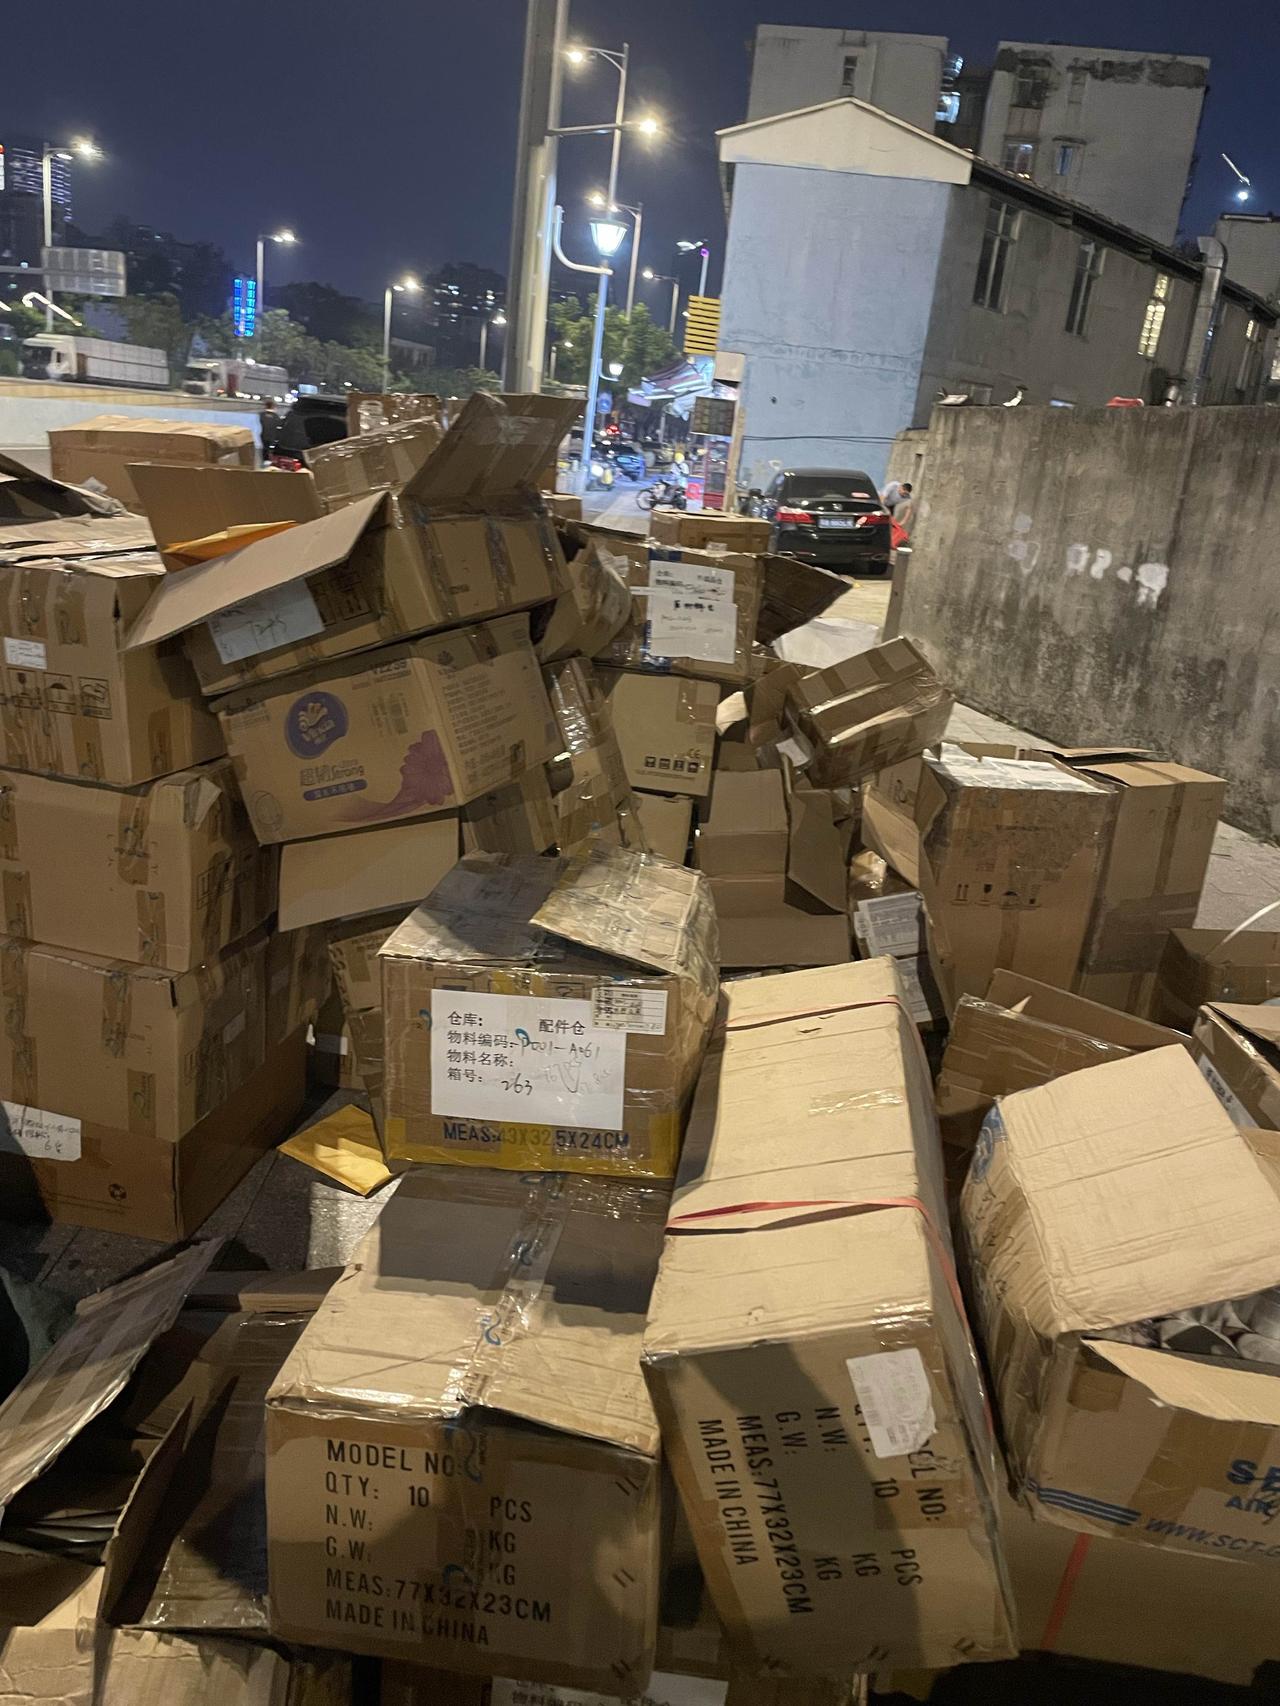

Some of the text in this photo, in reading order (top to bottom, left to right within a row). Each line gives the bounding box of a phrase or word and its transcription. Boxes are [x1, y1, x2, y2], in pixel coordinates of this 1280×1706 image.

[447, 1011, 586, 1036] 仓库: 配件仓
[447, 1030, 514, 1049] 物料编码:
[447, 1049, 514, 1068] 物料名称:
[447, 1067, 483, 1083] 箱号:
[327, 1438, 462, 1477] MODEL NO:
[325, 1471, 532, 1523] QTY: 10 PCS
[698, 1419, 759, 1566] MADE IN CHINA
[736, 1415, 814, 1615] MEAS:77X32X23CM
[775, 1410, 843, 1582] G.W: KG
[814, 1406, 881, 1578] N.W: KG
[916, 1487, 947, 1523] NO:
[325, 1504, 516, 1554] N.W: KG
[325, 1536, 372, 1563] G.W:
[871, 1477, 924, 1587] 10 PCS
[325, 1567, 551, 1624] MEAS:77X32X23CM
[325, 1599, 489, 1646] MADE IN CHINA
